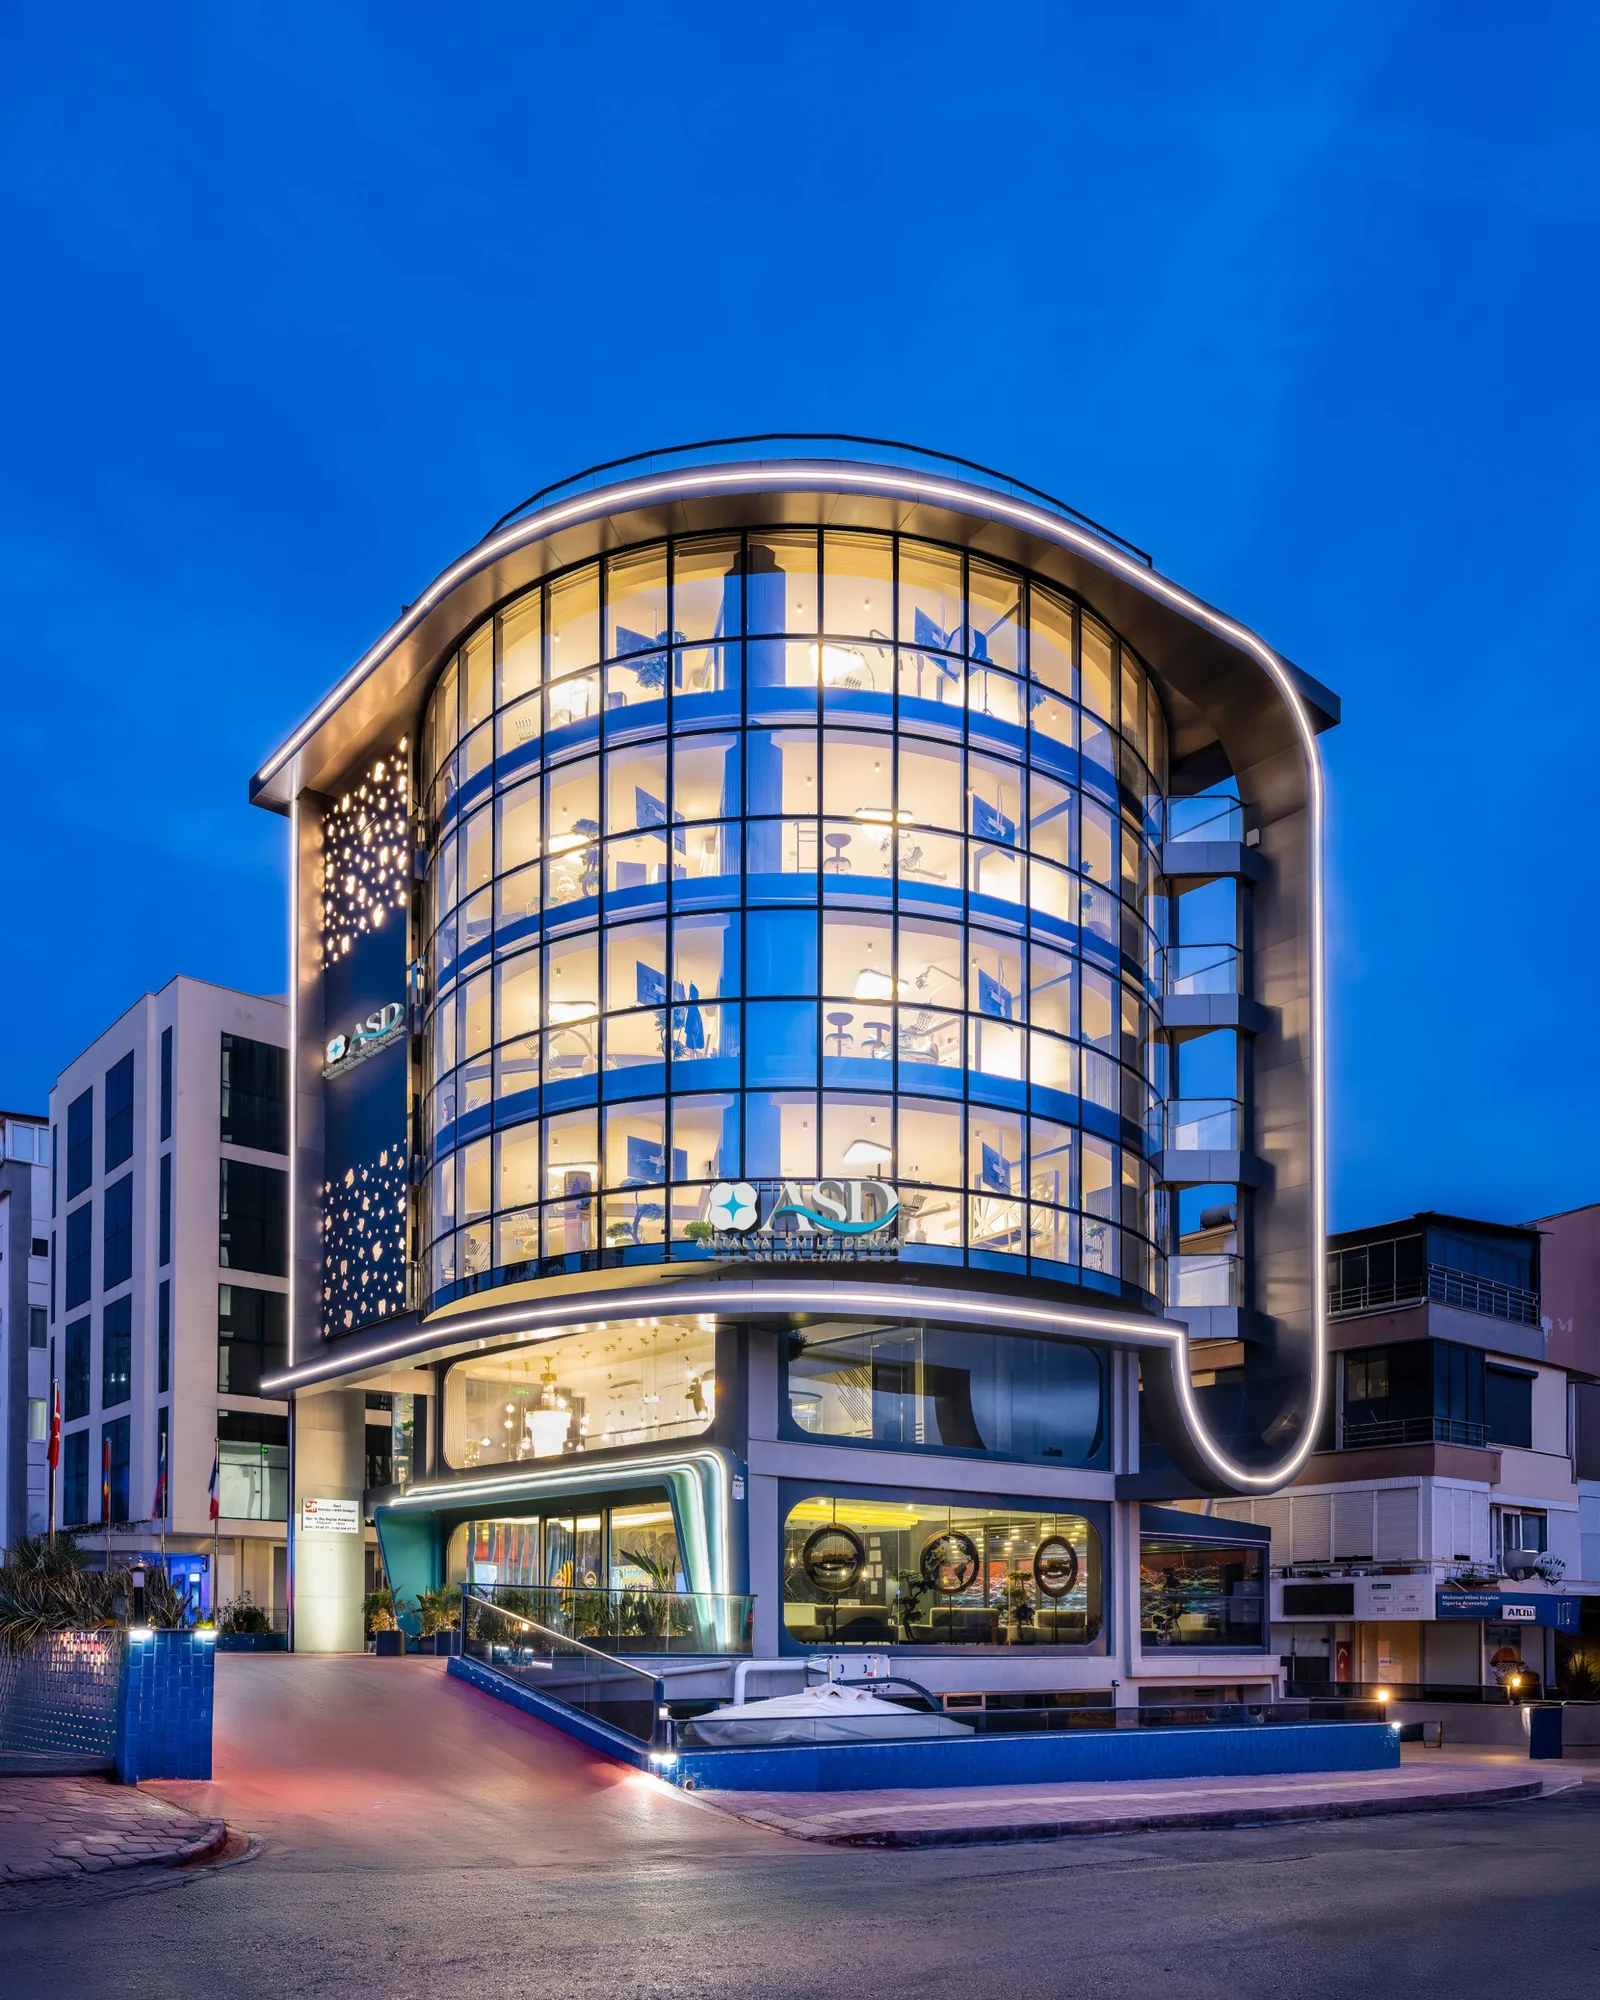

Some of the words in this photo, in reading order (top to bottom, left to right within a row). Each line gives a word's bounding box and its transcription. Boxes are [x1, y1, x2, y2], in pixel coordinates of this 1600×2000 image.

[347, 1002, 404, 1056] ASD
[758, 1180, 900, 1235] ASD
[696, 1236, 771, 1248] ANTALYA
[785, 1236, 835, 1248] SMILE
[844, 1236, 910, 1248] DENTAL
[754, 1252, 802, 1262] DENTAL
[811, 1252, 855, 1262] CLINIC
